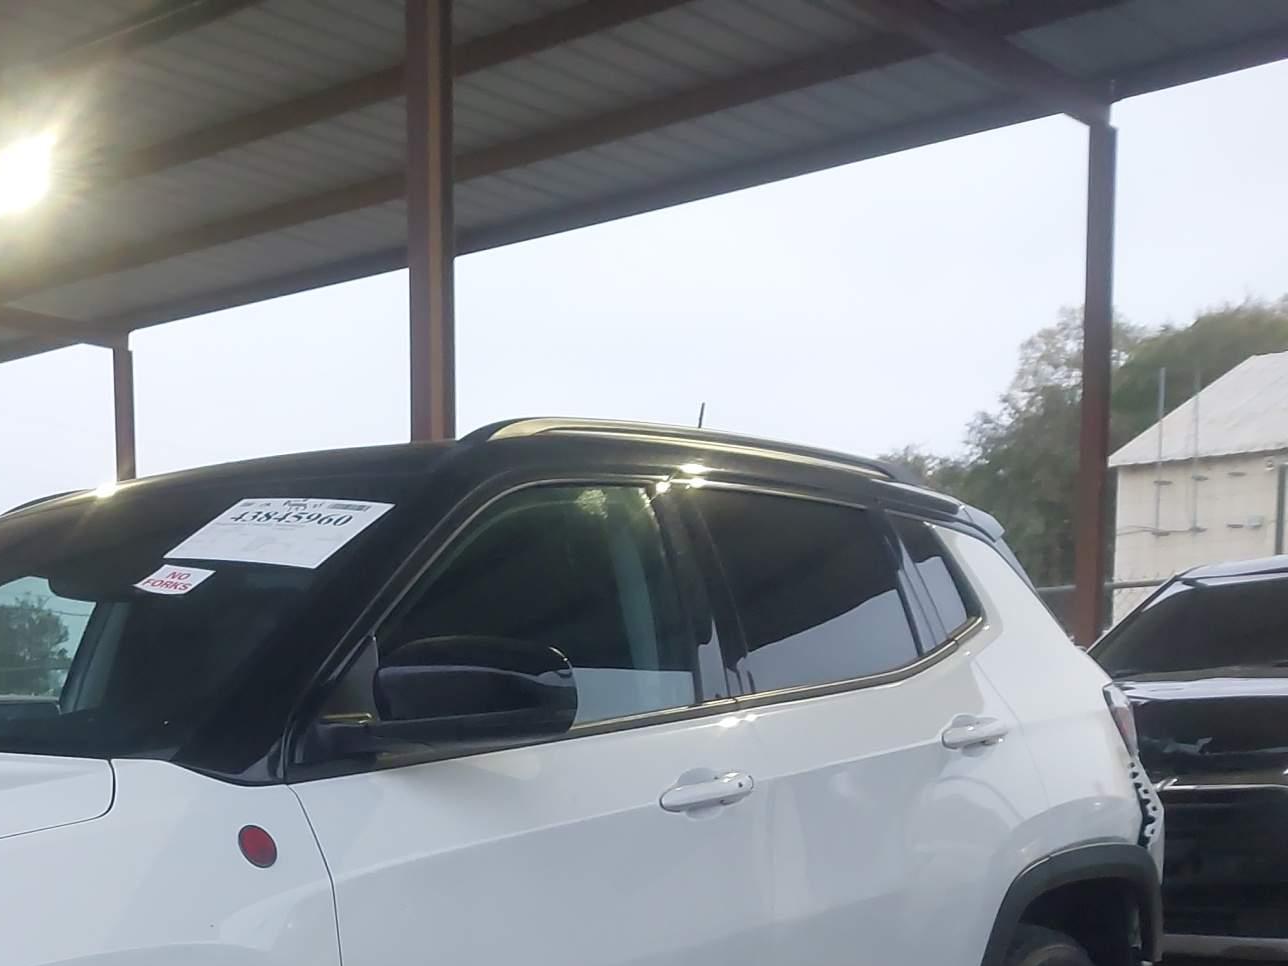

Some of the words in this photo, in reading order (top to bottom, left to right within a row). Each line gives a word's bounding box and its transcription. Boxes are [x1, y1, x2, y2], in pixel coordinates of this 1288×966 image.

[230, 510, 354, 527] 43845960
[166, 571, 192, 580] NO
[143, 578, 193, 591] FORKS
